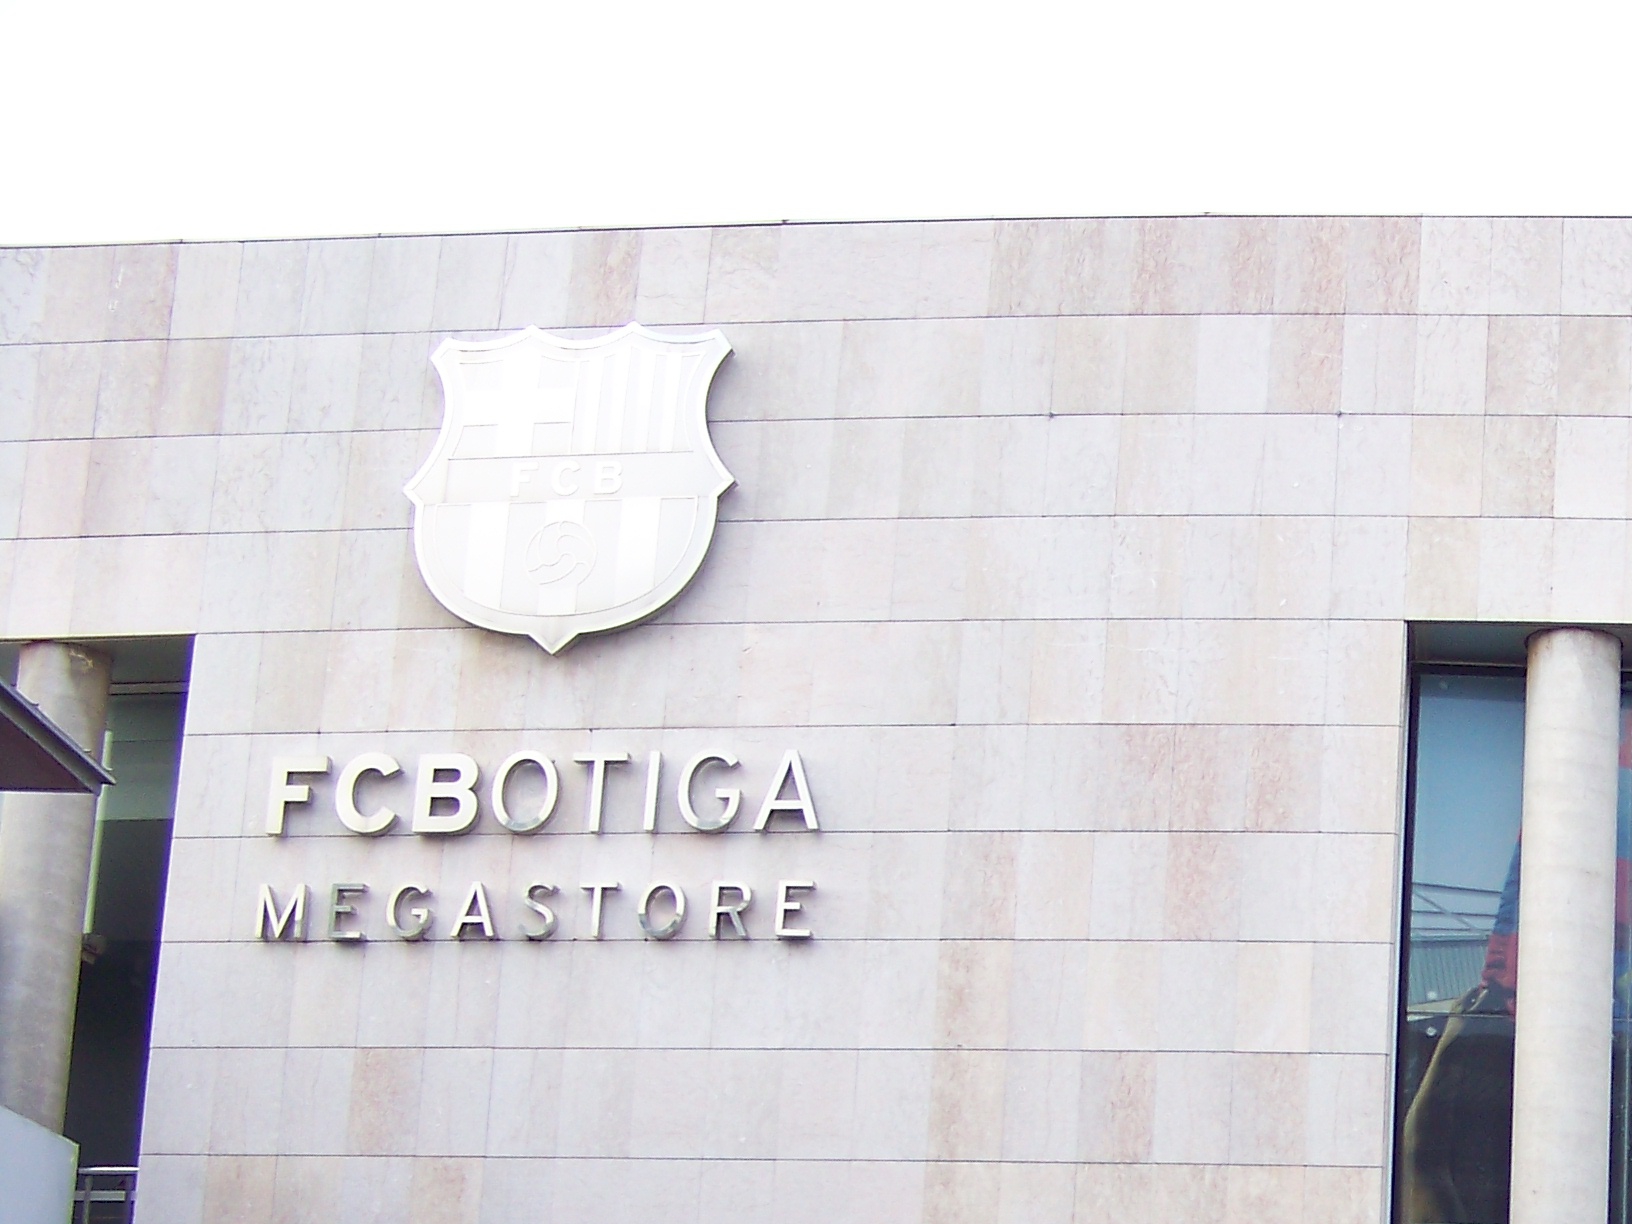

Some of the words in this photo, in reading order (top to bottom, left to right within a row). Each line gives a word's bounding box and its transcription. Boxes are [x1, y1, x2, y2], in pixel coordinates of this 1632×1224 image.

[510, 459, 625, 498] FCB
[265, 749, 823, 838] FCBOTIGA
[255, 880, 818, 942] MEGASTORE
